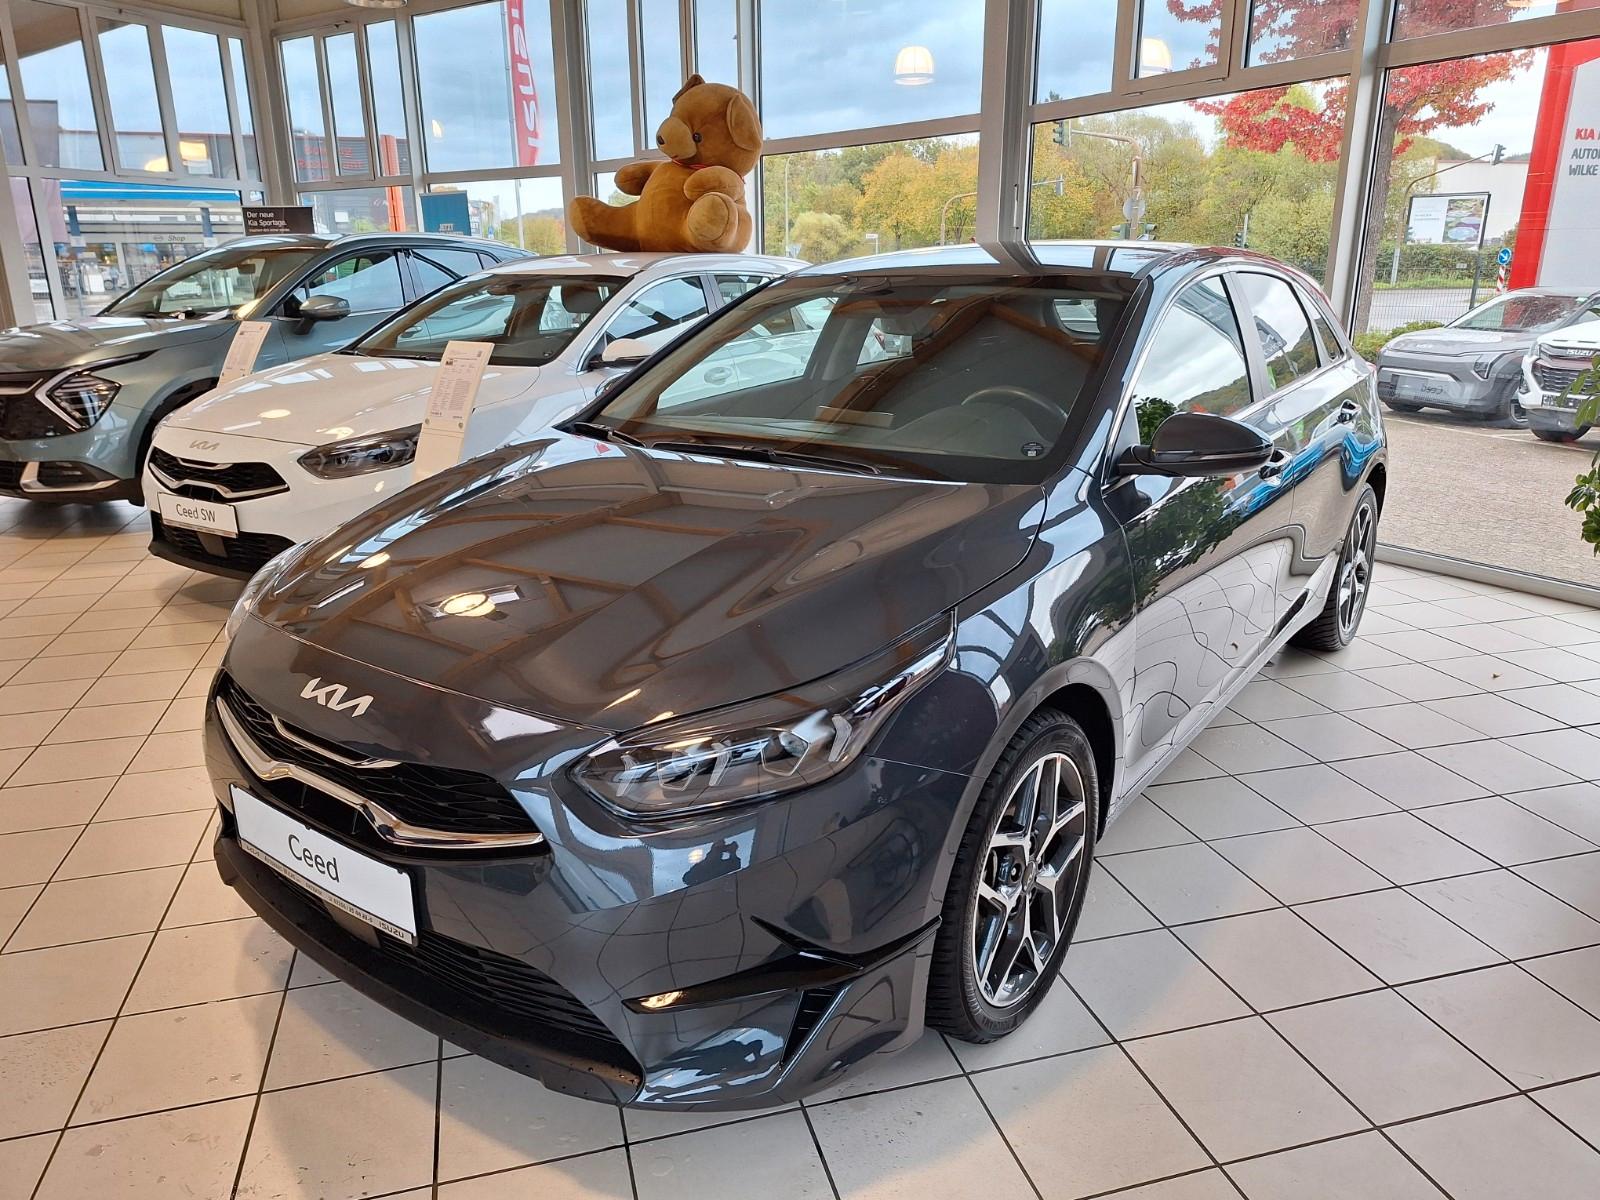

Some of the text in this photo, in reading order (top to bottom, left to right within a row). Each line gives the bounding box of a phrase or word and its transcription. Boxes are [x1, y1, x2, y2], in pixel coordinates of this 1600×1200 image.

[1575, 128, 1595, 140] KIA
[1571, 147, 1600, 160] AUTO
[1569, 164, 1599, 176] WILKE
[167, 234, 186, 242] Shop
[1566, 349, 1593, 357] ISUZU
[189, 439, 220, 451] KIA
[176, 503, 216, 522] Ceed SW
[300, 676, 375, 718] KIA
[288, 833, 340, 883] Ceed
[378, 920, 405, 939] ISUZU
